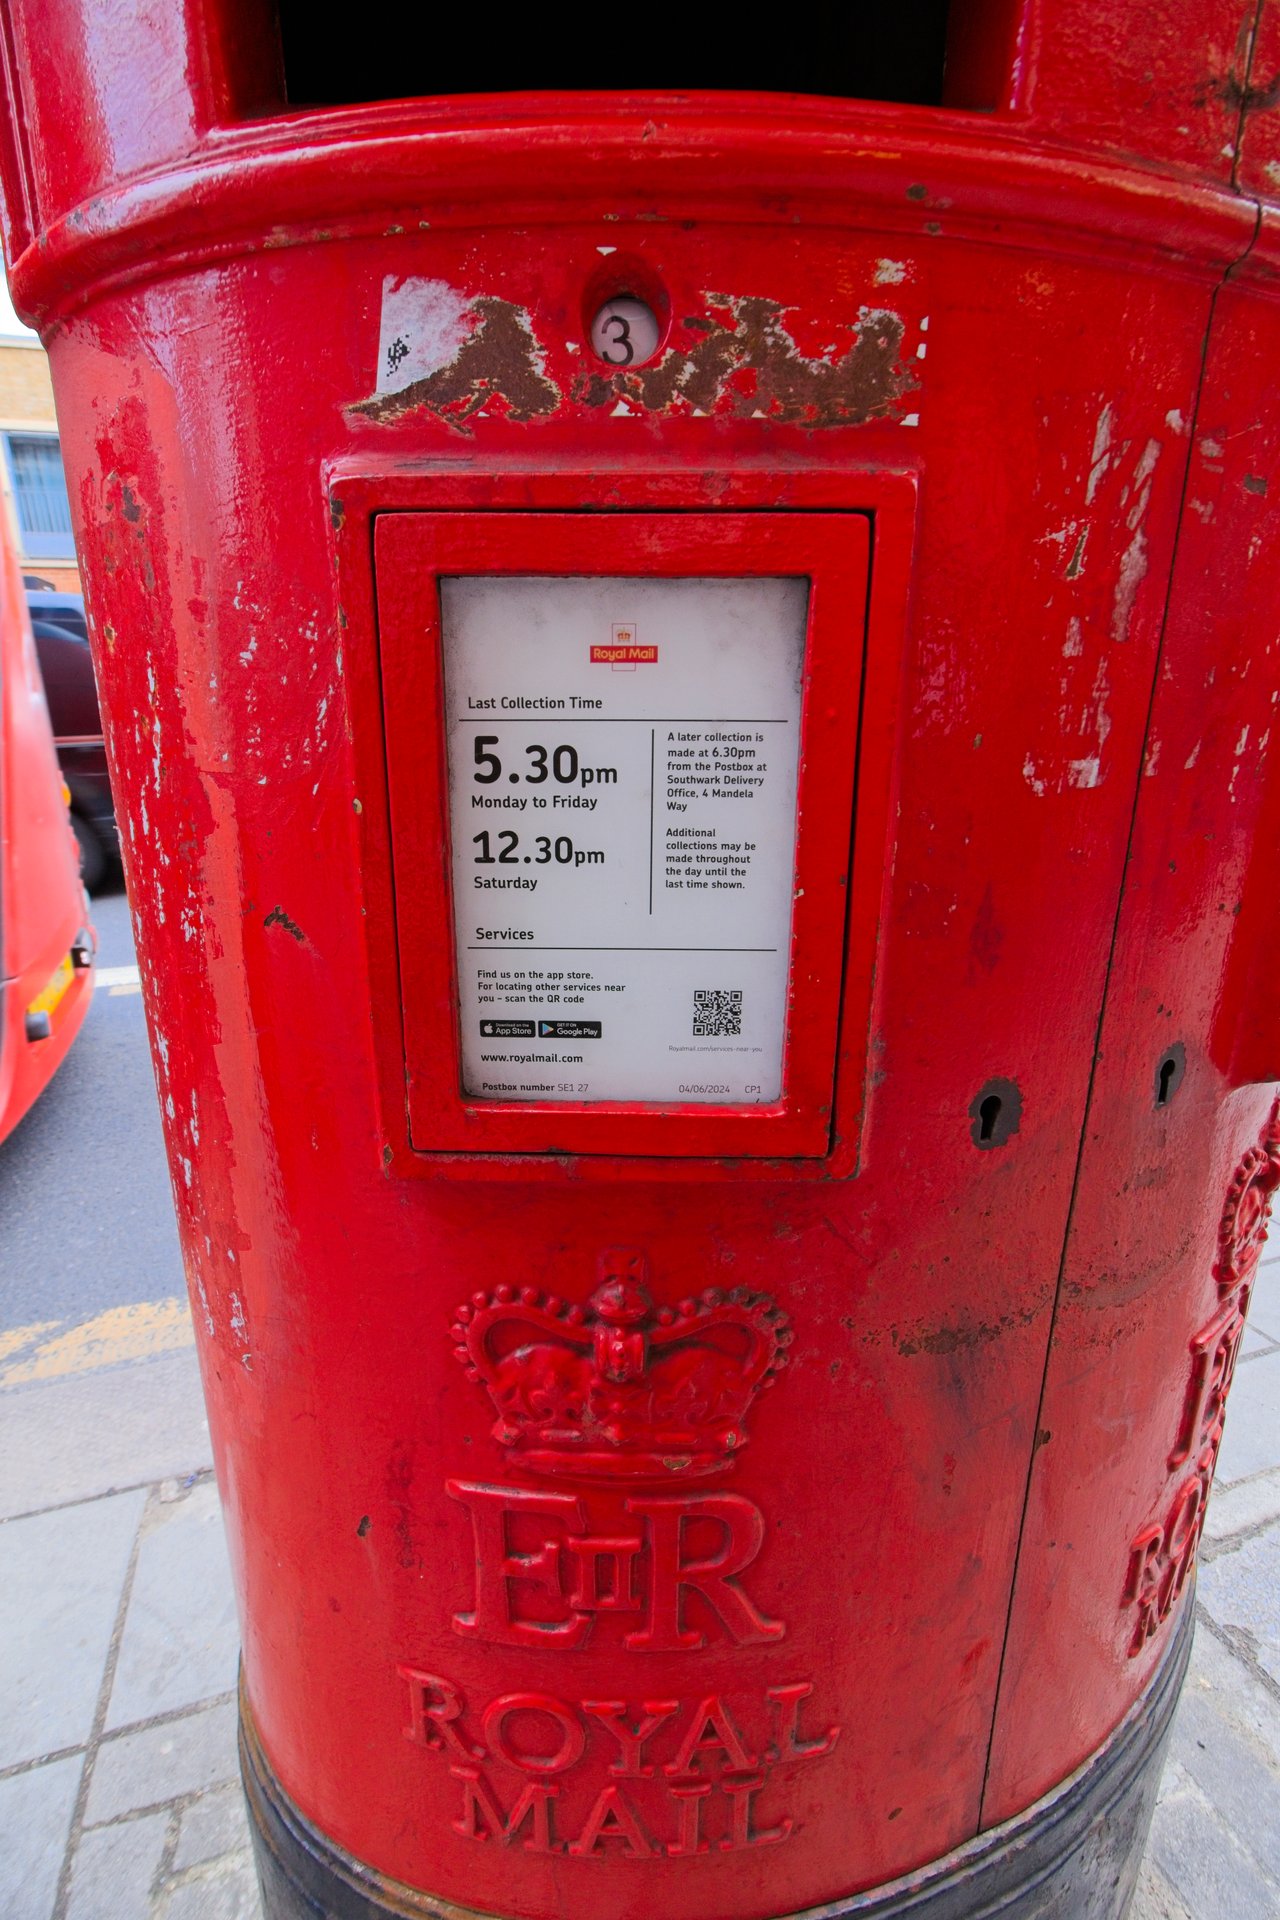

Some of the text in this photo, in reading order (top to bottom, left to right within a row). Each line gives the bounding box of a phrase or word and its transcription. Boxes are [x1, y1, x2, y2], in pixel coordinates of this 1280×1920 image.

[601, 314, 634, 366] 3
[593, 647, 655, 662] Royal Mail
[468, 696, 603, 709] Last Collection Time
[667, 731, 764, 743] A later collection is
[667, 747, 756, 760] made at 6.30pm
[473, 736, 618, 788] 5.30pm
[667, 761, 768, 772] from the Postbox at
[667, 774, 764, 787] Southwark Delivery
[667, 788, 754, 799] Office, 4 Mandela
[471, 794, 598, 812] Monday to Friday
[667, 801, 688, 812] Way
[666, 827, 716, 838] Additional
[472, 829, 605, 868] 12.30pm
[666, 840, 756, 853] collections may be
[666, 853, 751, 866] made throughout
[666, 866, 747, 878] the day until the
[473, 875, 538, 892] Saturday
[665, 879, 745, 890] last time shown.
[475, 926, 535, 941] Services
[477, 969, 594, 982] Find us on the app store.
[478, 981, 626, 993] For locating other services near
[478, 994, 494, 1005] you
[505, 994, 526, 1004] scan
[528, 993, 544, 1004] the
[547, 994, 561, 1005] QR
[563, 994, 585, 1005] code
[495, 1027, 532, 1036] App Store
[557, 1027, 598, 1037] Google Play
[480, 1052, 584, 1065] www.royalmail.com
[482, 1081, 589, 1093] Postbox number SE1 27
[678, 1084, 762, 1095] 04/06/2024 CP1
[398, 1664, 842, 1778] ROYAL
[448, 1764, 794, 1860] MAIL
